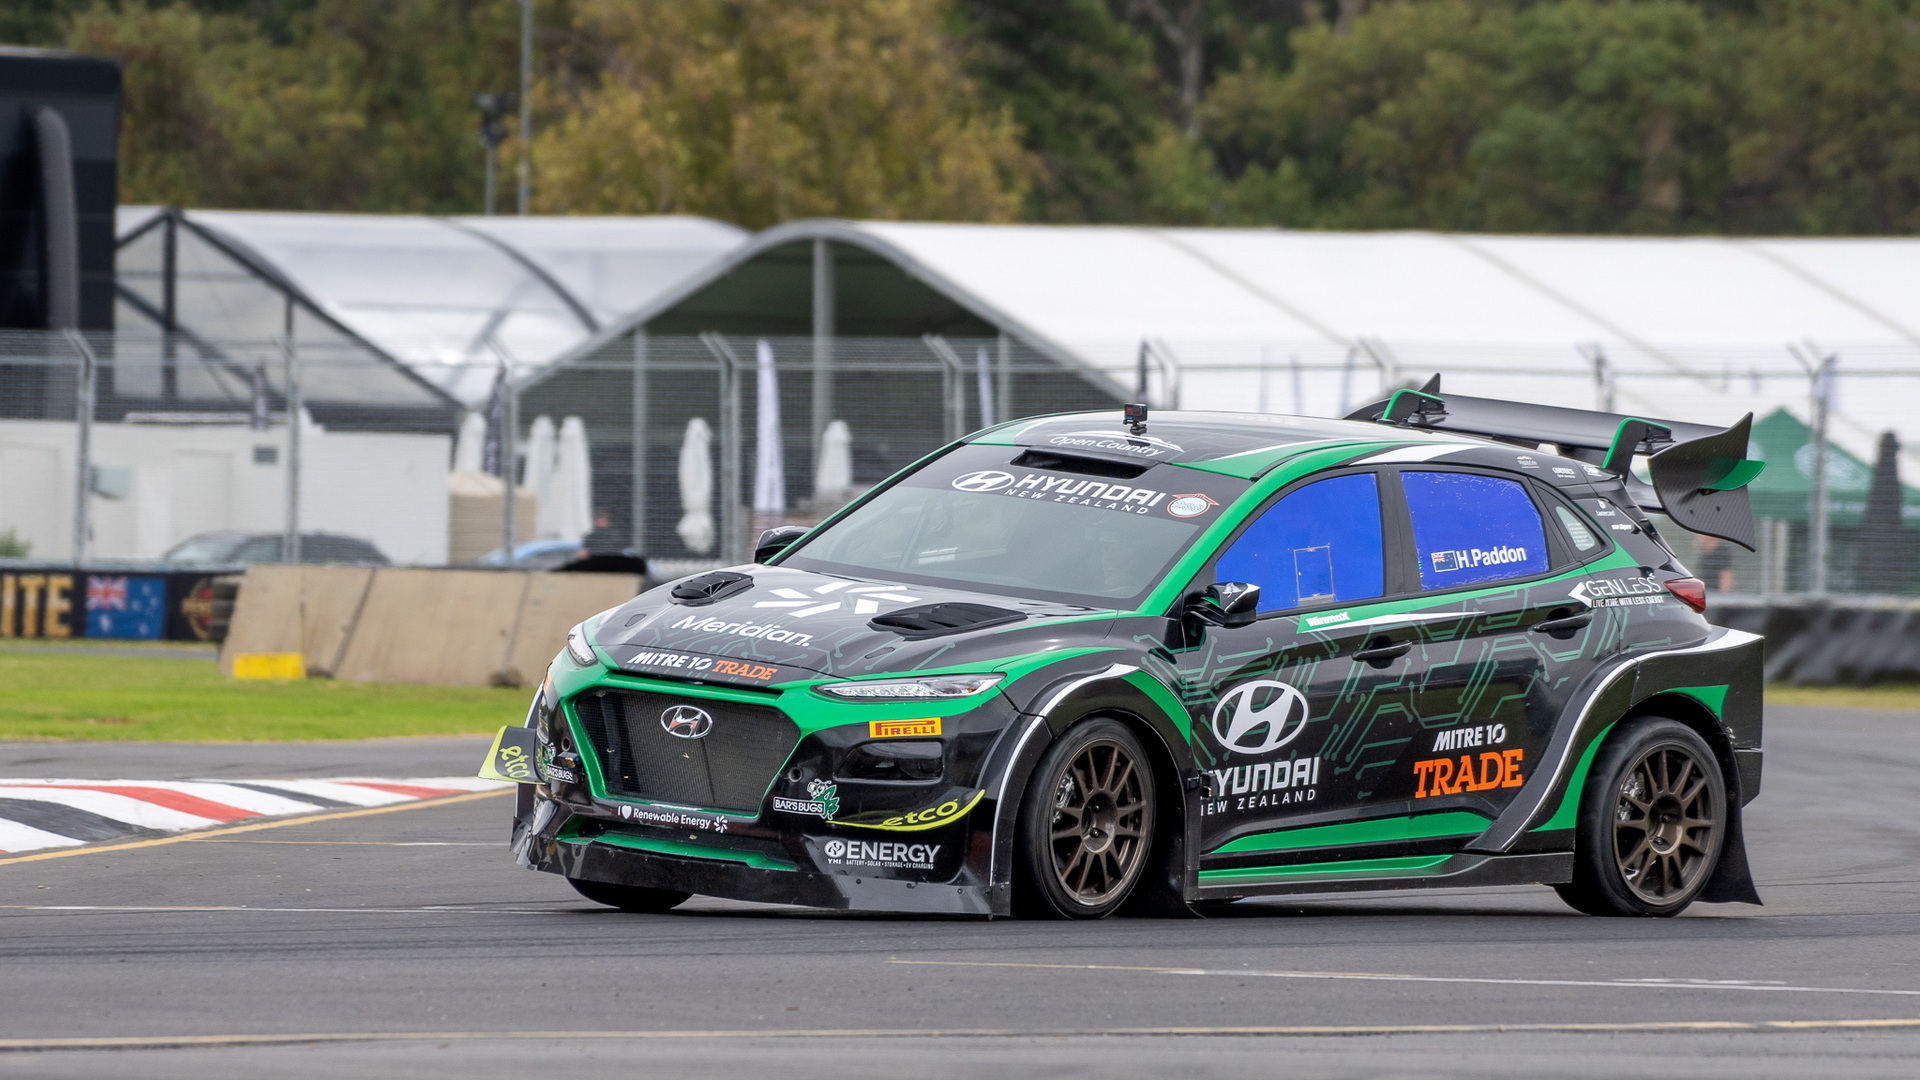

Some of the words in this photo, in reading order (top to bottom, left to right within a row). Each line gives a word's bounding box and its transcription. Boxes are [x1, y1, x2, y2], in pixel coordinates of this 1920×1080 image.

[1049, 436, 1096, 447] Open
[1096, 440, 1165, 457] Country
[1004, 488, 1046, 500] NEW
[1053, 494, 1149, 515] ZEALAND
[1014, 474, 1166, 507] HYUNDAI
[1456, 545, 1528, 570] H.Paddon
[1632, 596, 1646, 605] LESS
[670, 615, 811, 647] Meridian.
[627, 652, 688, 669] MITRE
[688, 657, 713, 671] 10
[712, 658, 779, 681] TRADE
[875, 720, 936, 736] PIRELLI
[1432, 728, 1482, 752] MITRE
[1486, 723, 1506, 744] 10
[499, 745, 530, 778] etco
[1413, 748, 1524, 798] TRADE
[1202, 756, 1320, 799] YUNDAI
[775, 800, 798, 810] BAR'S
[798, 801, 823, 812] BUGS
[1237, 789, 1317, 810] ZEALAND
[633, 808, 679, 823] Renewable
[681, 814, 711, 830] Energy
[882, 801, 958, 827] etco
[846, 840, 941, 863] ENERGY
